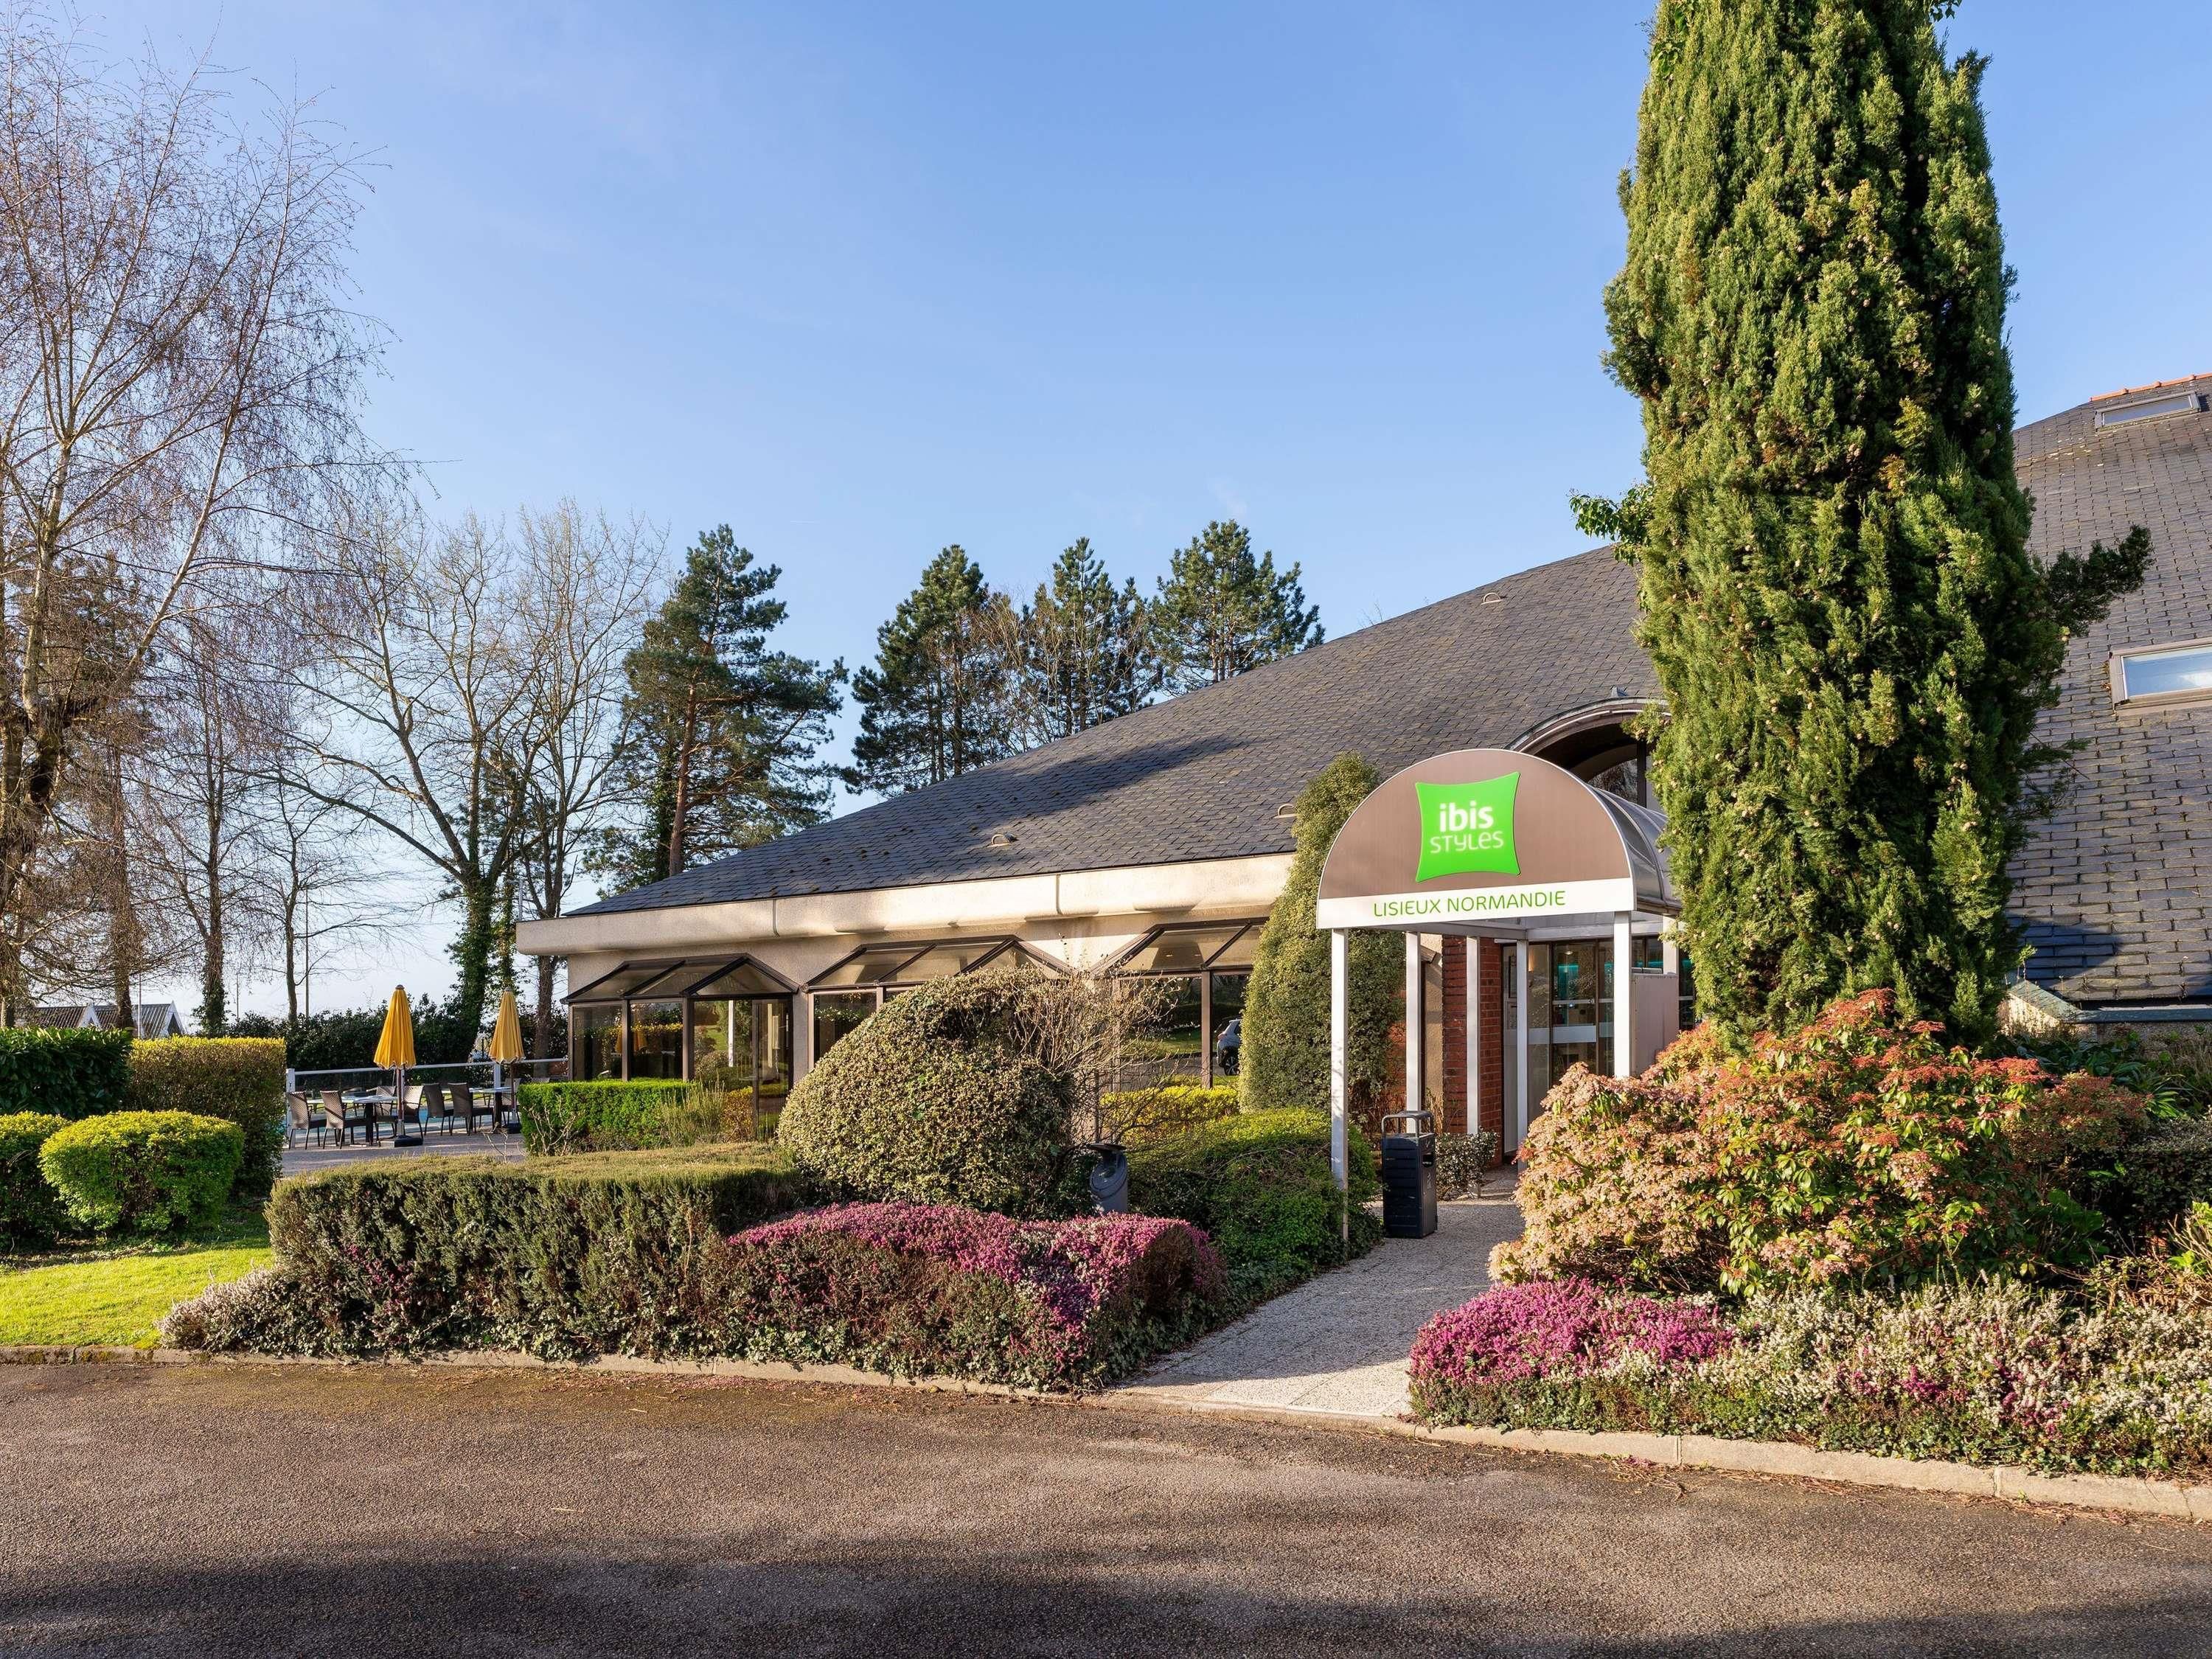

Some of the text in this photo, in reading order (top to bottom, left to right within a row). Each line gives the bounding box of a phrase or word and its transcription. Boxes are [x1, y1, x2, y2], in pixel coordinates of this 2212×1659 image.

[1439, 799, 1495, 832] ibis
[1373, 890, 1566, 917] LISIEUX NORMANDIE
